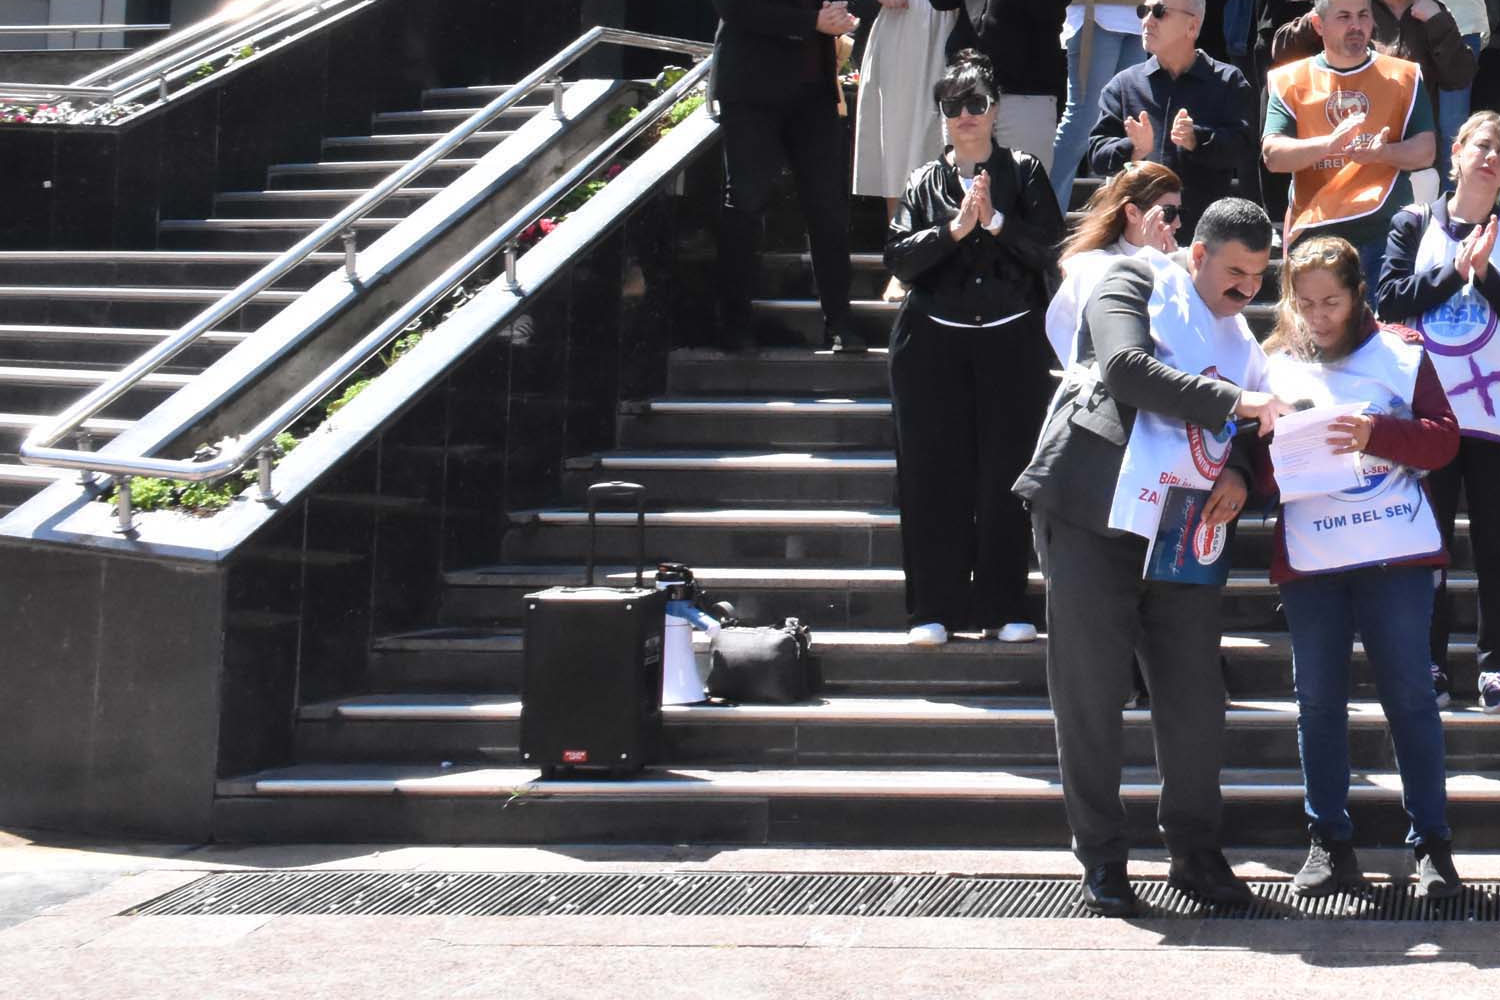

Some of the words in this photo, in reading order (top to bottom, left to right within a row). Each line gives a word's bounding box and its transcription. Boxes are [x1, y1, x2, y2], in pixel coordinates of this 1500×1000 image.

[1362, 464, 1389, 475] L-SEN
[1313, 515, 1347, 532] TÜM
[1352, 509, 1382, 524] BEL
[1386, 503, 1413, 518] SEN
